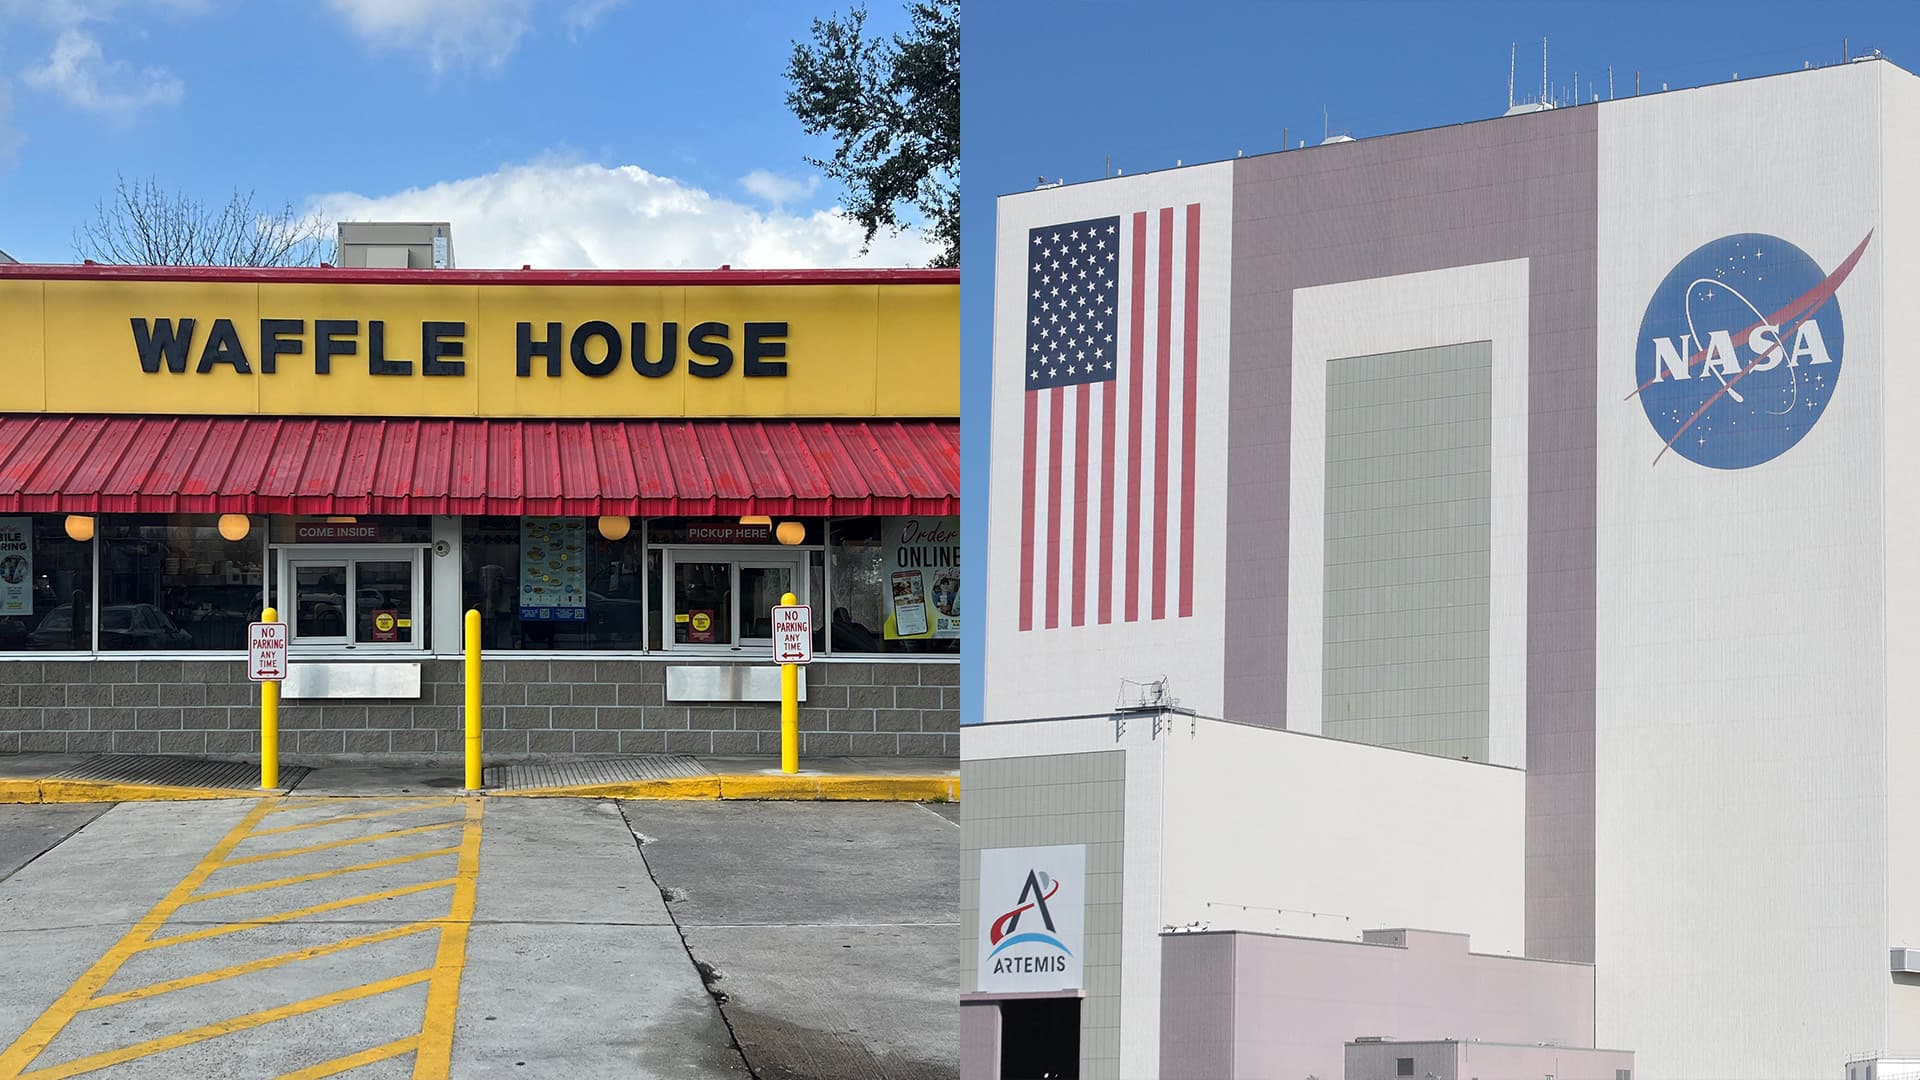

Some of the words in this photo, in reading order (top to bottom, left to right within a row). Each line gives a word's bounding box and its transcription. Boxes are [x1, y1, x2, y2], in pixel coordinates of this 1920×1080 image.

[130, 318, 465, 376] WAFFLE
[516, 320, 788, 377] HOUSE
[1652, 319, 1832, 383] NASA
[299, 527, 334, 537] COME
[337, 527, 375, 537] INSIDE
[689, 528, 733, 538] PICKUP
[736, 528, 767, 538] HERE
[901, 520, 958, 544] Order
[897, 546, 960, 568] ONLINE
[785, 611, 798, 621] NO
[776, 622, 807, 632] PARKING
[261, 628, 275, 638] NO
[784, 634, 800, 642] ANY
[253, 639, 283, 649] PARKING
[260, 651, 276, 659] ANY
[259, 660, 277, 668] TIME
[993, 955, 1066, 974] ARTEMIS
